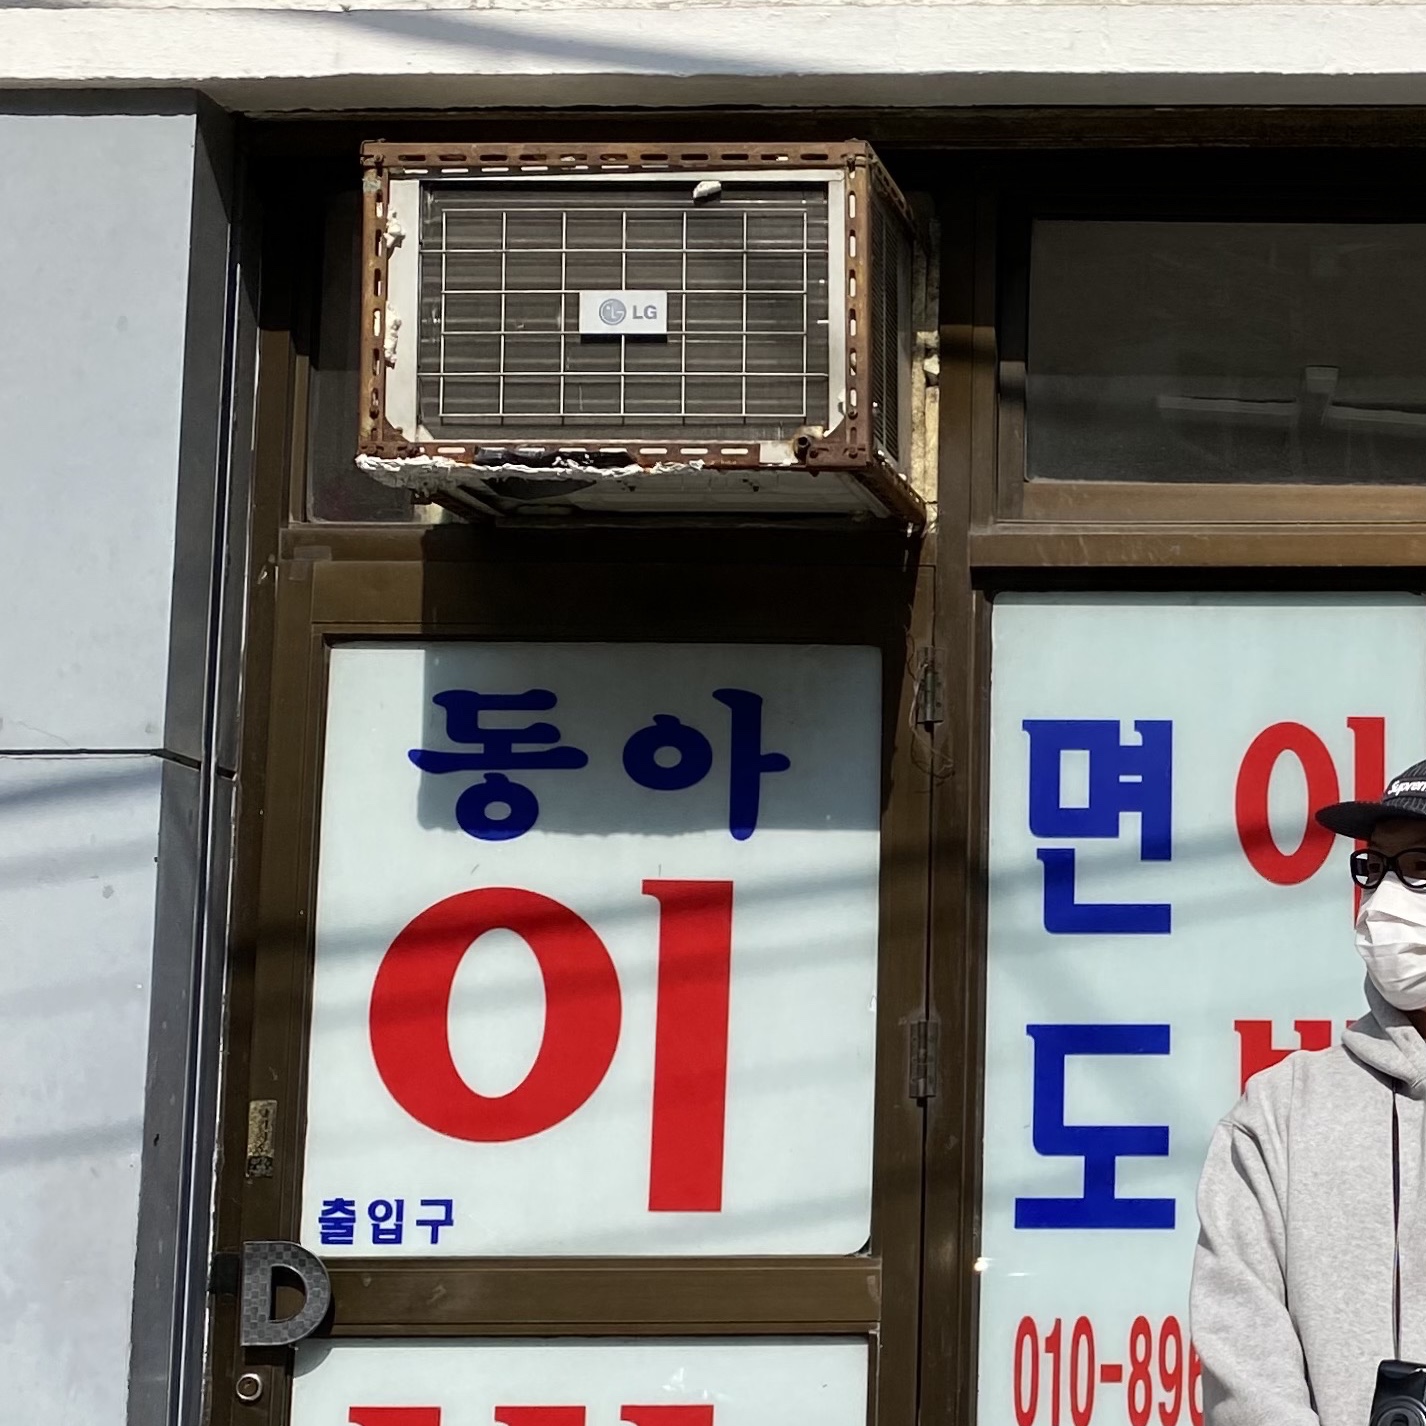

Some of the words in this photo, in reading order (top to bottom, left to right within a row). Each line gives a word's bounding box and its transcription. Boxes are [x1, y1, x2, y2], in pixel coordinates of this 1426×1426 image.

[632, 305, 658, 320] LG
[408, 688, 791, 841] 동아
[1014, 719, 1176, 1229] 면도
[1235, 716, 1385, 1096] 이
[318, 1198, 454, 1245] 출입구
